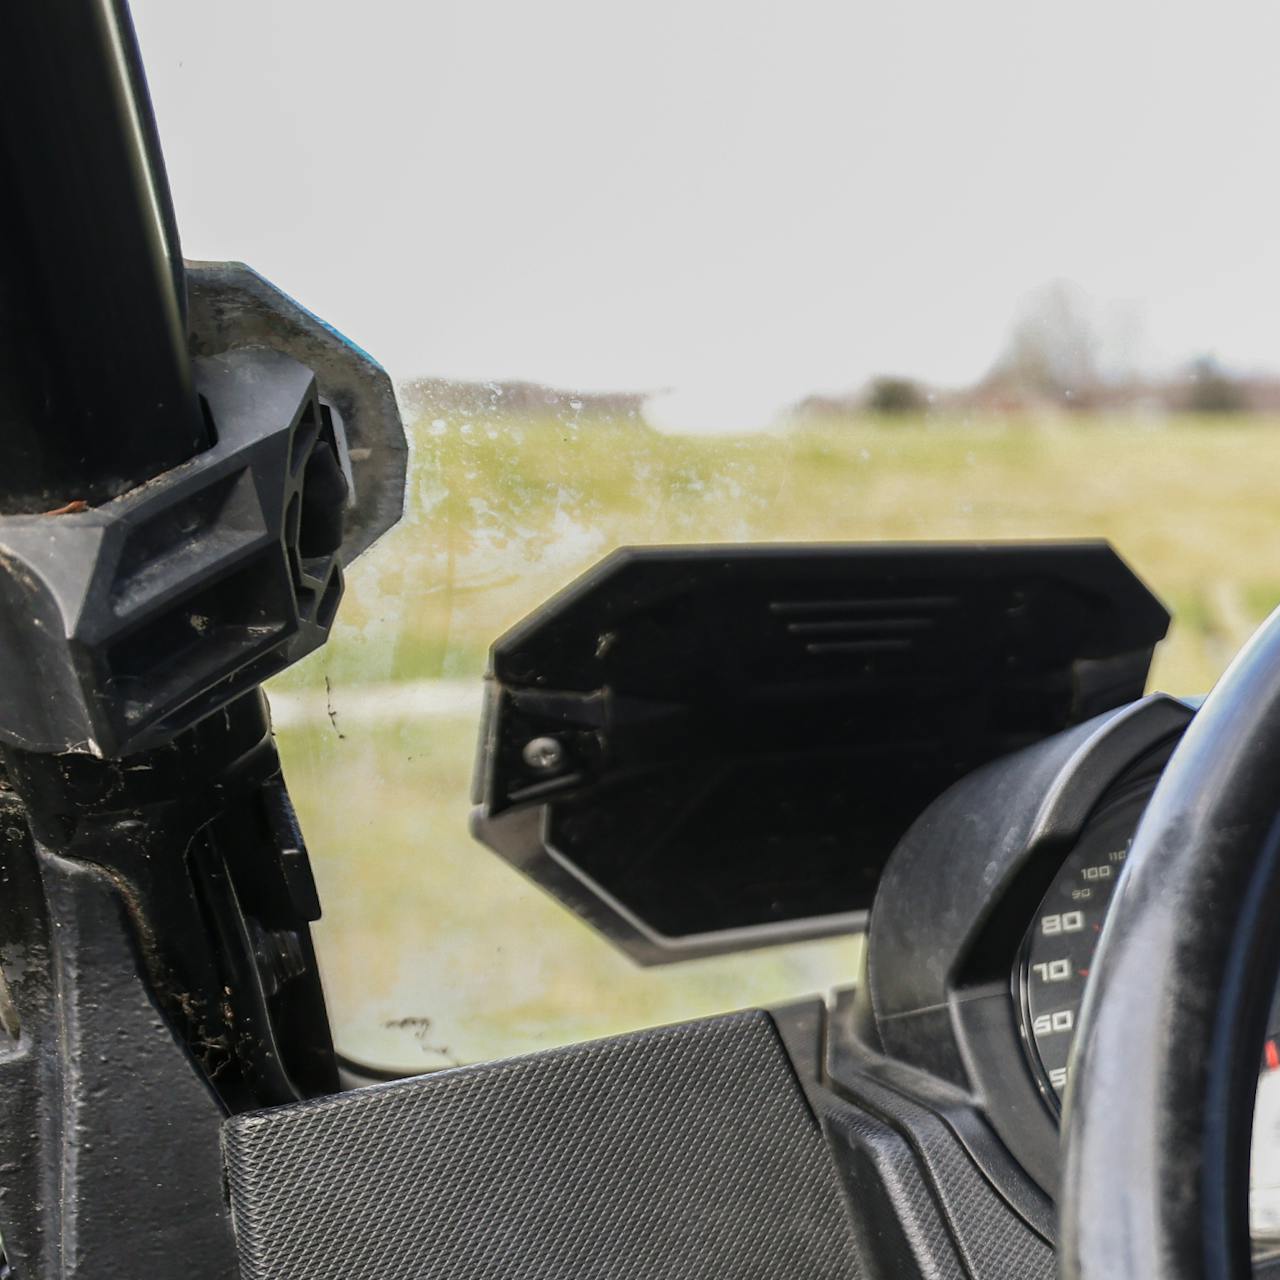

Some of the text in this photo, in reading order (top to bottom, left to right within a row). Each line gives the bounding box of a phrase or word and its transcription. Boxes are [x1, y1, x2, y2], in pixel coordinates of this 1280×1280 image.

[1109, 850, 1126, 862] 110
[1081, 865, 1110, 881] 100
[1072, 888, 1090, 899] 90
[1041, 911, 1082, 935] 80
[1033, 959, 1071, 982] 70
[1033, 1010, 1073, 1035] 60
